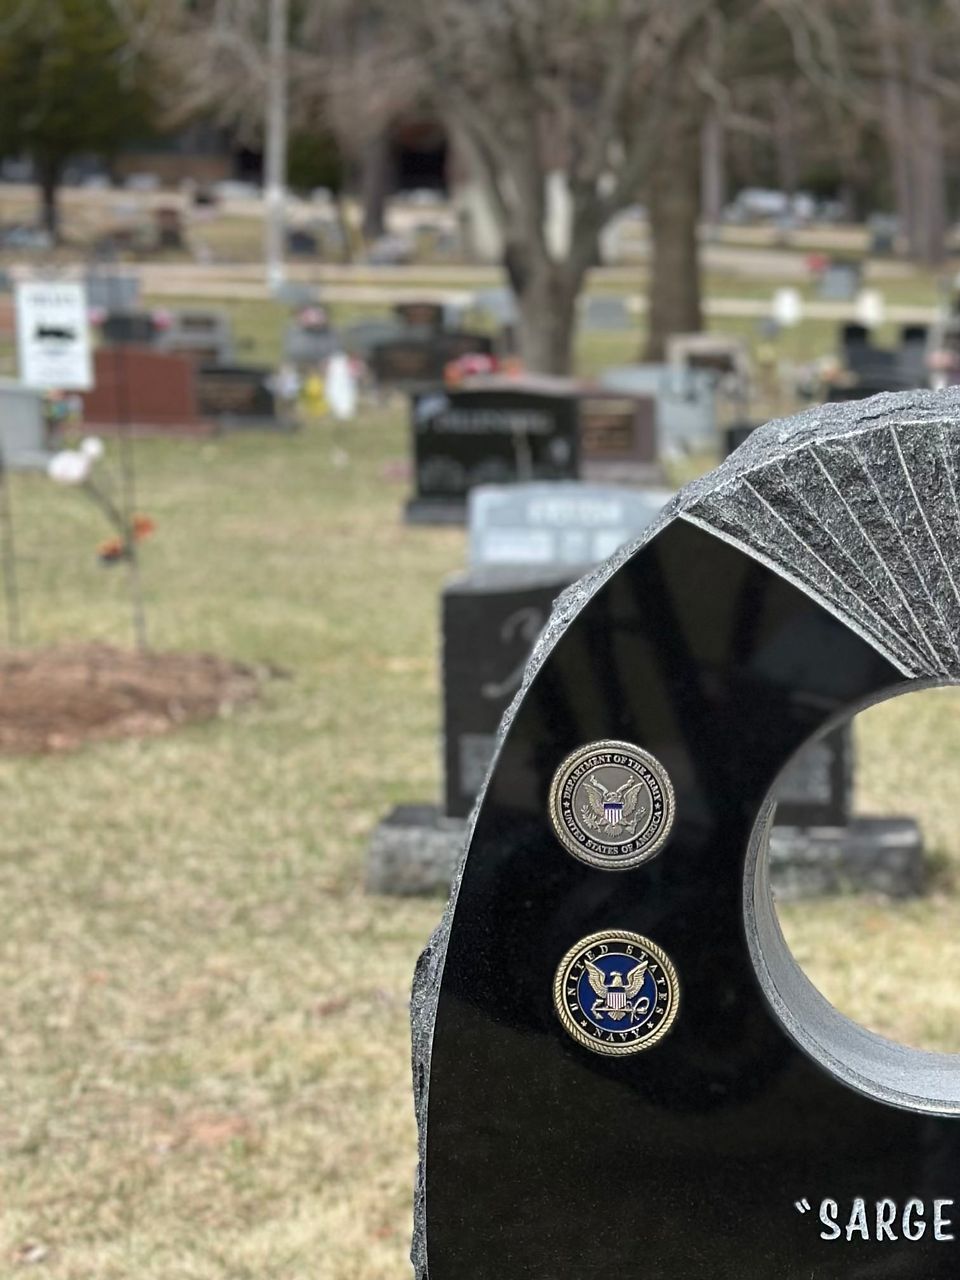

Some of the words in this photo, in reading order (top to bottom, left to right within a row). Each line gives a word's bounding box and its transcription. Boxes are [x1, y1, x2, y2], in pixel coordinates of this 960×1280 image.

[563, 754, 612, 800] DEPARTMENT
[613, 754, 626, 765] OF
[627, 758, 646, 776] THE
[643, 773, 662, 804] ARMY
[564, 809, 586, 843] UNITED
[585, 840, 619, 855] STATES
[621, 842, 634, 854] OF
[635, 810, 662, 849] AMERICA
[567, 944, 609, 1011] UNITED
[625, 945, 667, 1015] STATES
[592, 1028, 641, 1041] NAVY
